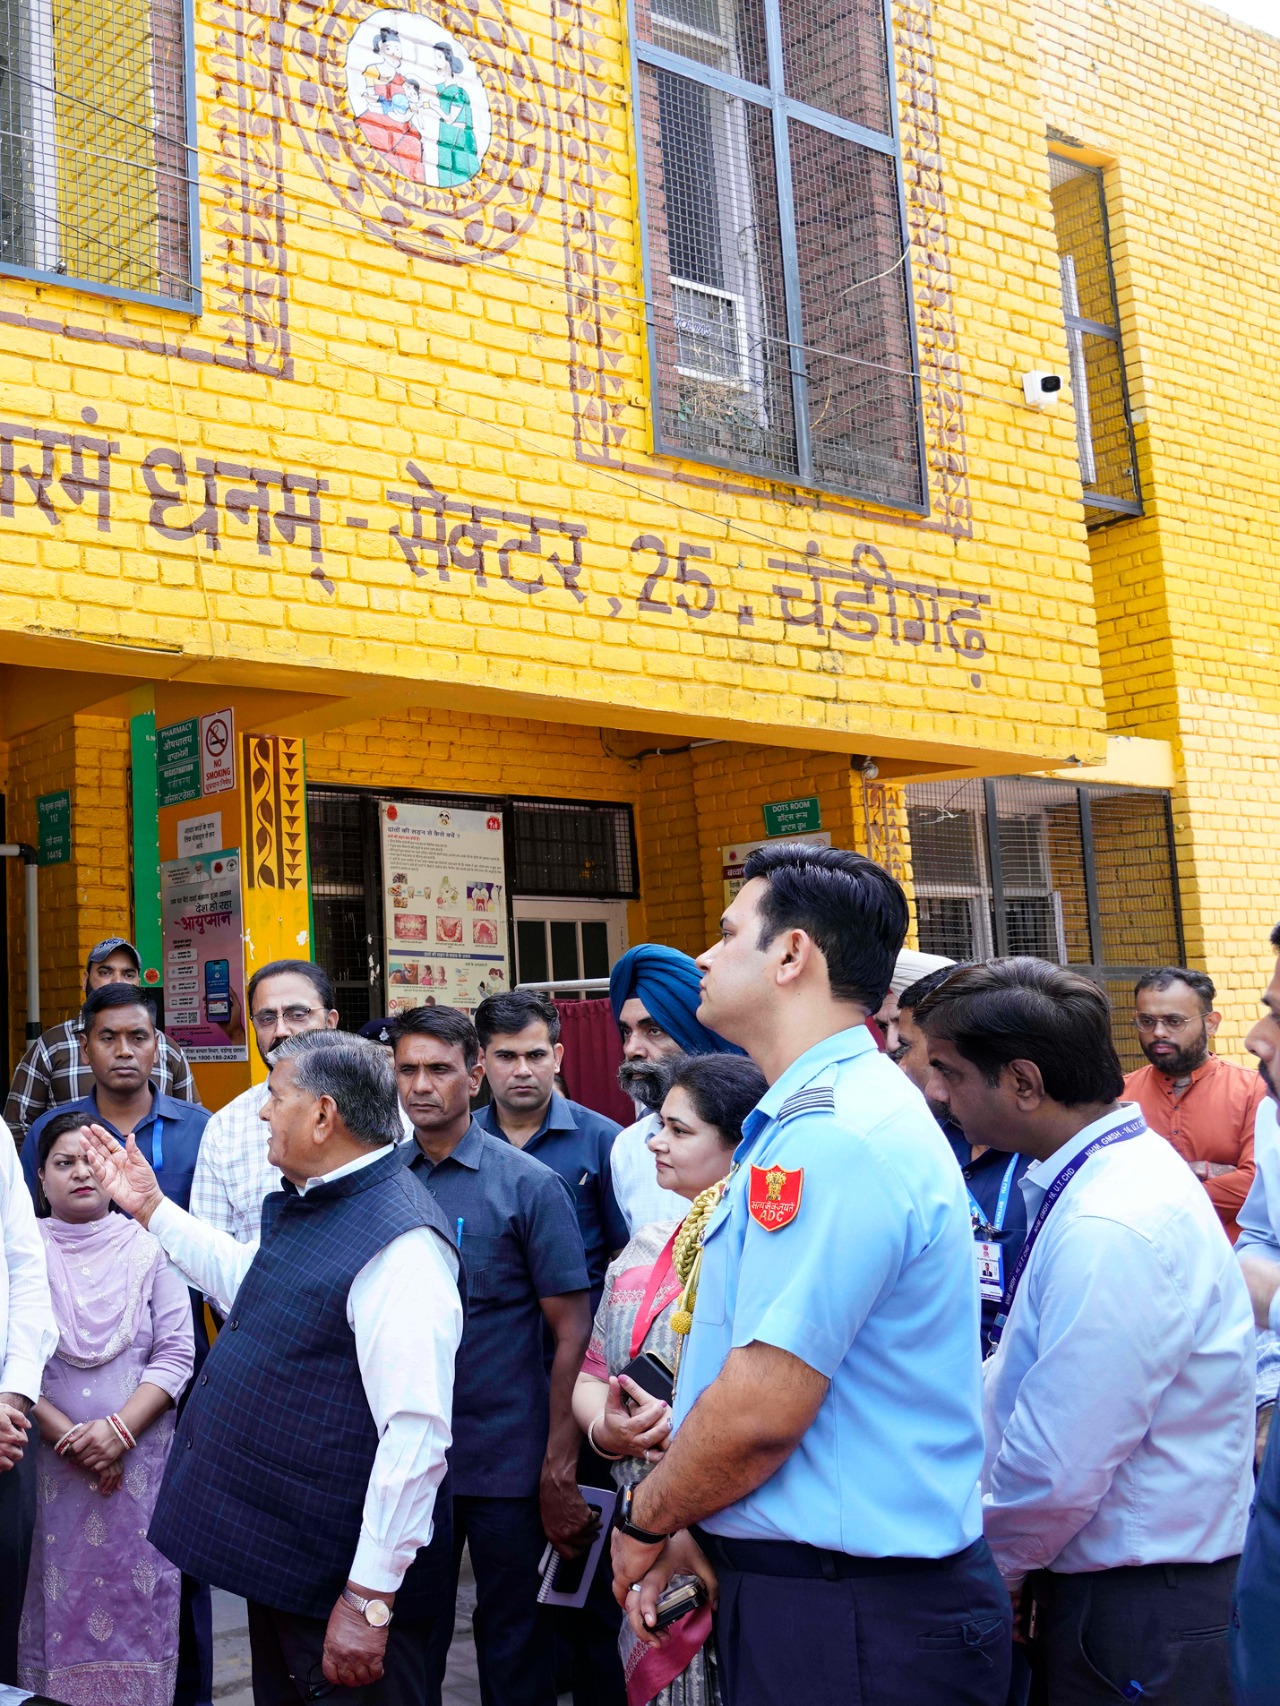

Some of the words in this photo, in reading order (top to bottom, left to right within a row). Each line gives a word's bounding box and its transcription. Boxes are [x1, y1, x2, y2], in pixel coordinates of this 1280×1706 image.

[139, 446, 336, 595] धनम्
[768, 540, 992, 690] चंडीगढ़
[161, 723, 193, 738] PHARMACY
[164, 763, 194, 778] REGISTRATION
[213, 758, 222, 768] NO
[206, 767, 231, 781] SMOKING
[772, 804, 789, 813] DOTS
[790, 801, 810, 810] ROOM
[195, 902, 208, 913] देश
[209, 900, 217, 911] हो
[219, 900, 232, 910] रहा
[174, 910, 232, 934] आयुष्मान
[1101, 1130, 1122, 1145] GMSH
[1053, 1179, 1065, 1193] U.T.
[1061, 1167, 1075, 1181] CHD
[760, 1210, 784, 1222] ADC
